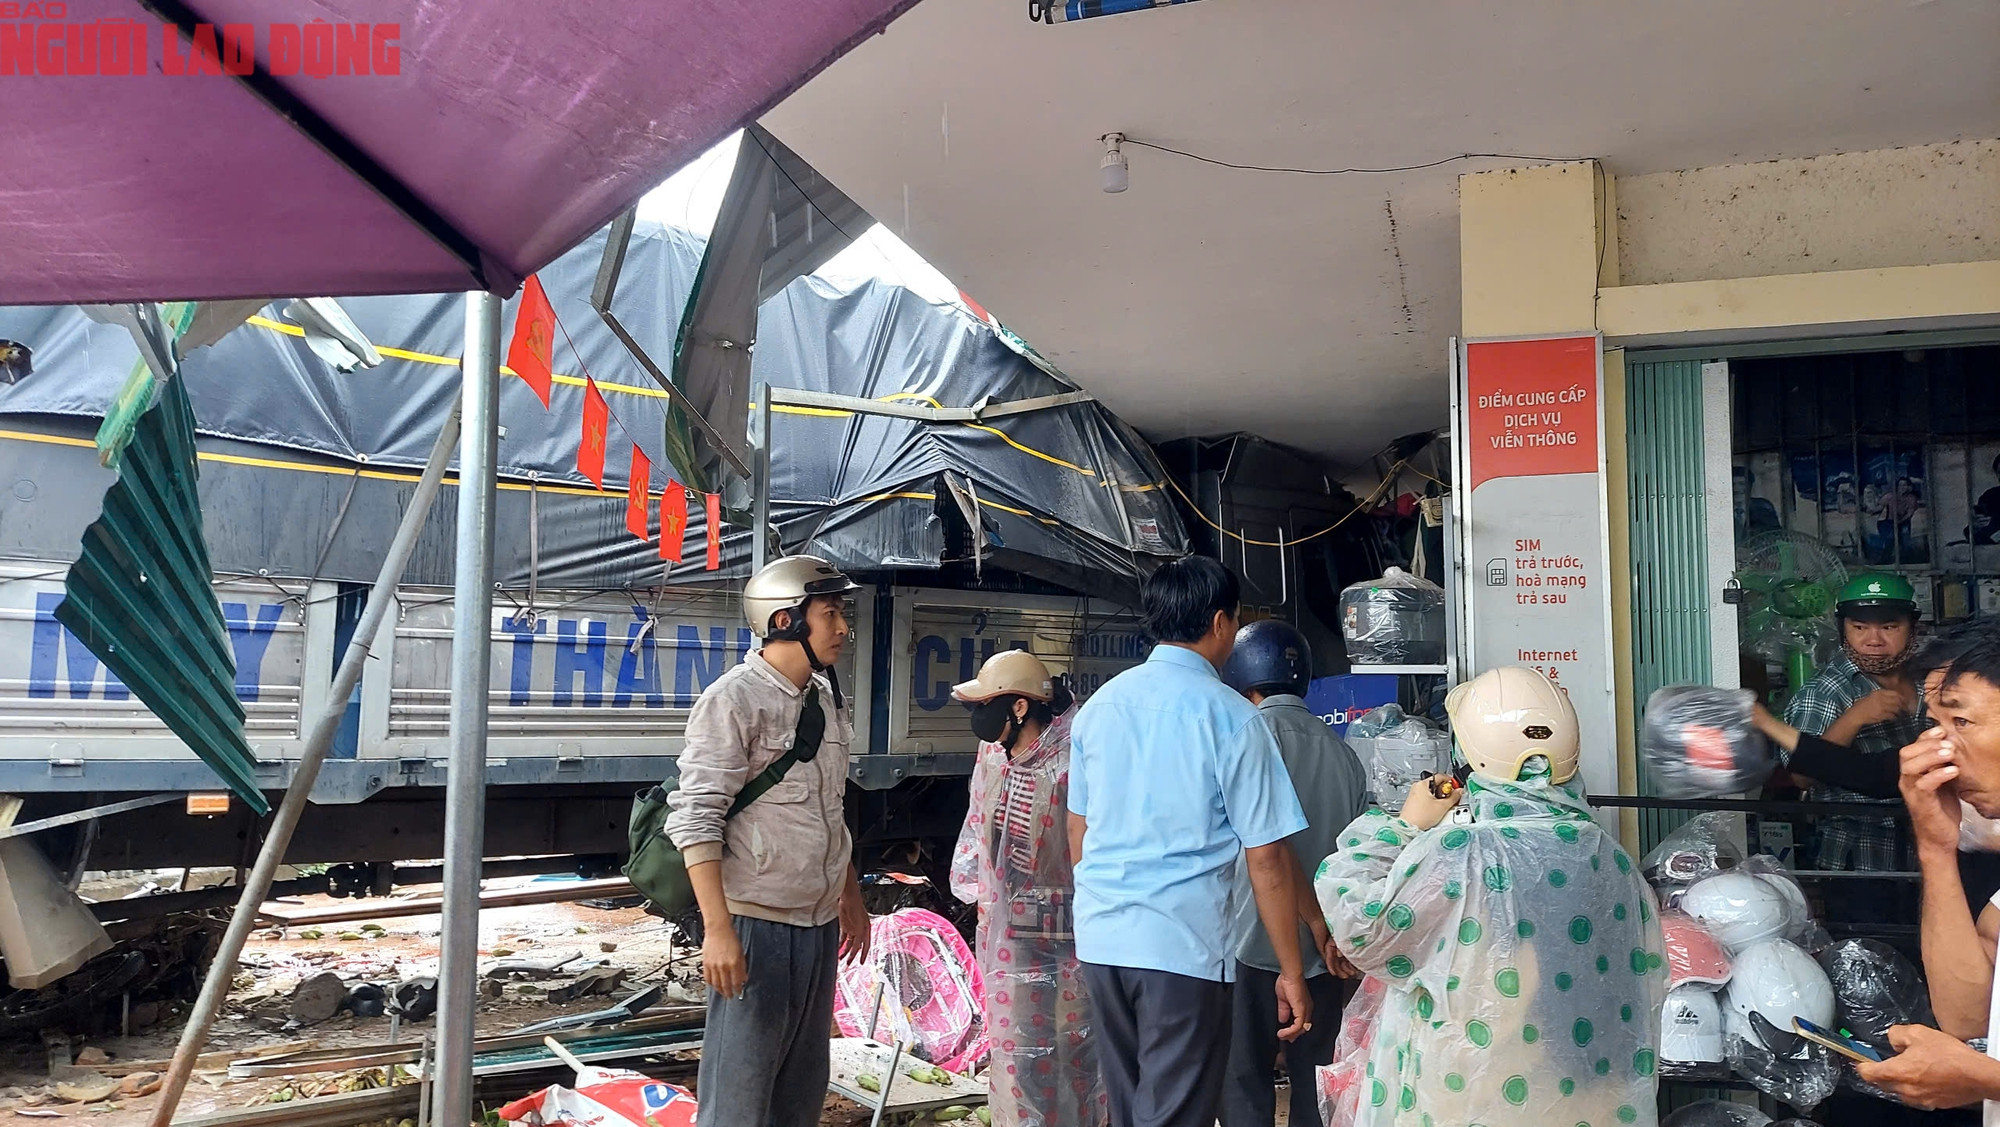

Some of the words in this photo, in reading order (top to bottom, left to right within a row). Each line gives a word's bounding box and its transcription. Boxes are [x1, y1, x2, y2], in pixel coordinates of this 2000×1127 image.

[1478, 388, 1513, 409] ĐIỂM
[1516, 392, 1555, 406] CUNG
[1558, 383, 1587, 403] CẤP
[1504, 413, 1538, 429] DỊCH
[1541, 411, 1562, 427] VỤ
[1490, 429, 1524, 448] VIỄN
[1527, 430, 1577, 446] THÔNG
[1515, 539, 1541, 552] SIM
[1515, 555, 1537, 569] trả
[1541, 554, 1584, 570] trước,
[1516, 573, 1542, 587] hoà
[1546, 575, 1587, 589] mạng
[1516, 590, 1538, 604] trả
[1542, 594, 1567, 604] sau
[28, 592, 284, 702] MY
[1518, 648, 1578, 661] Internet
